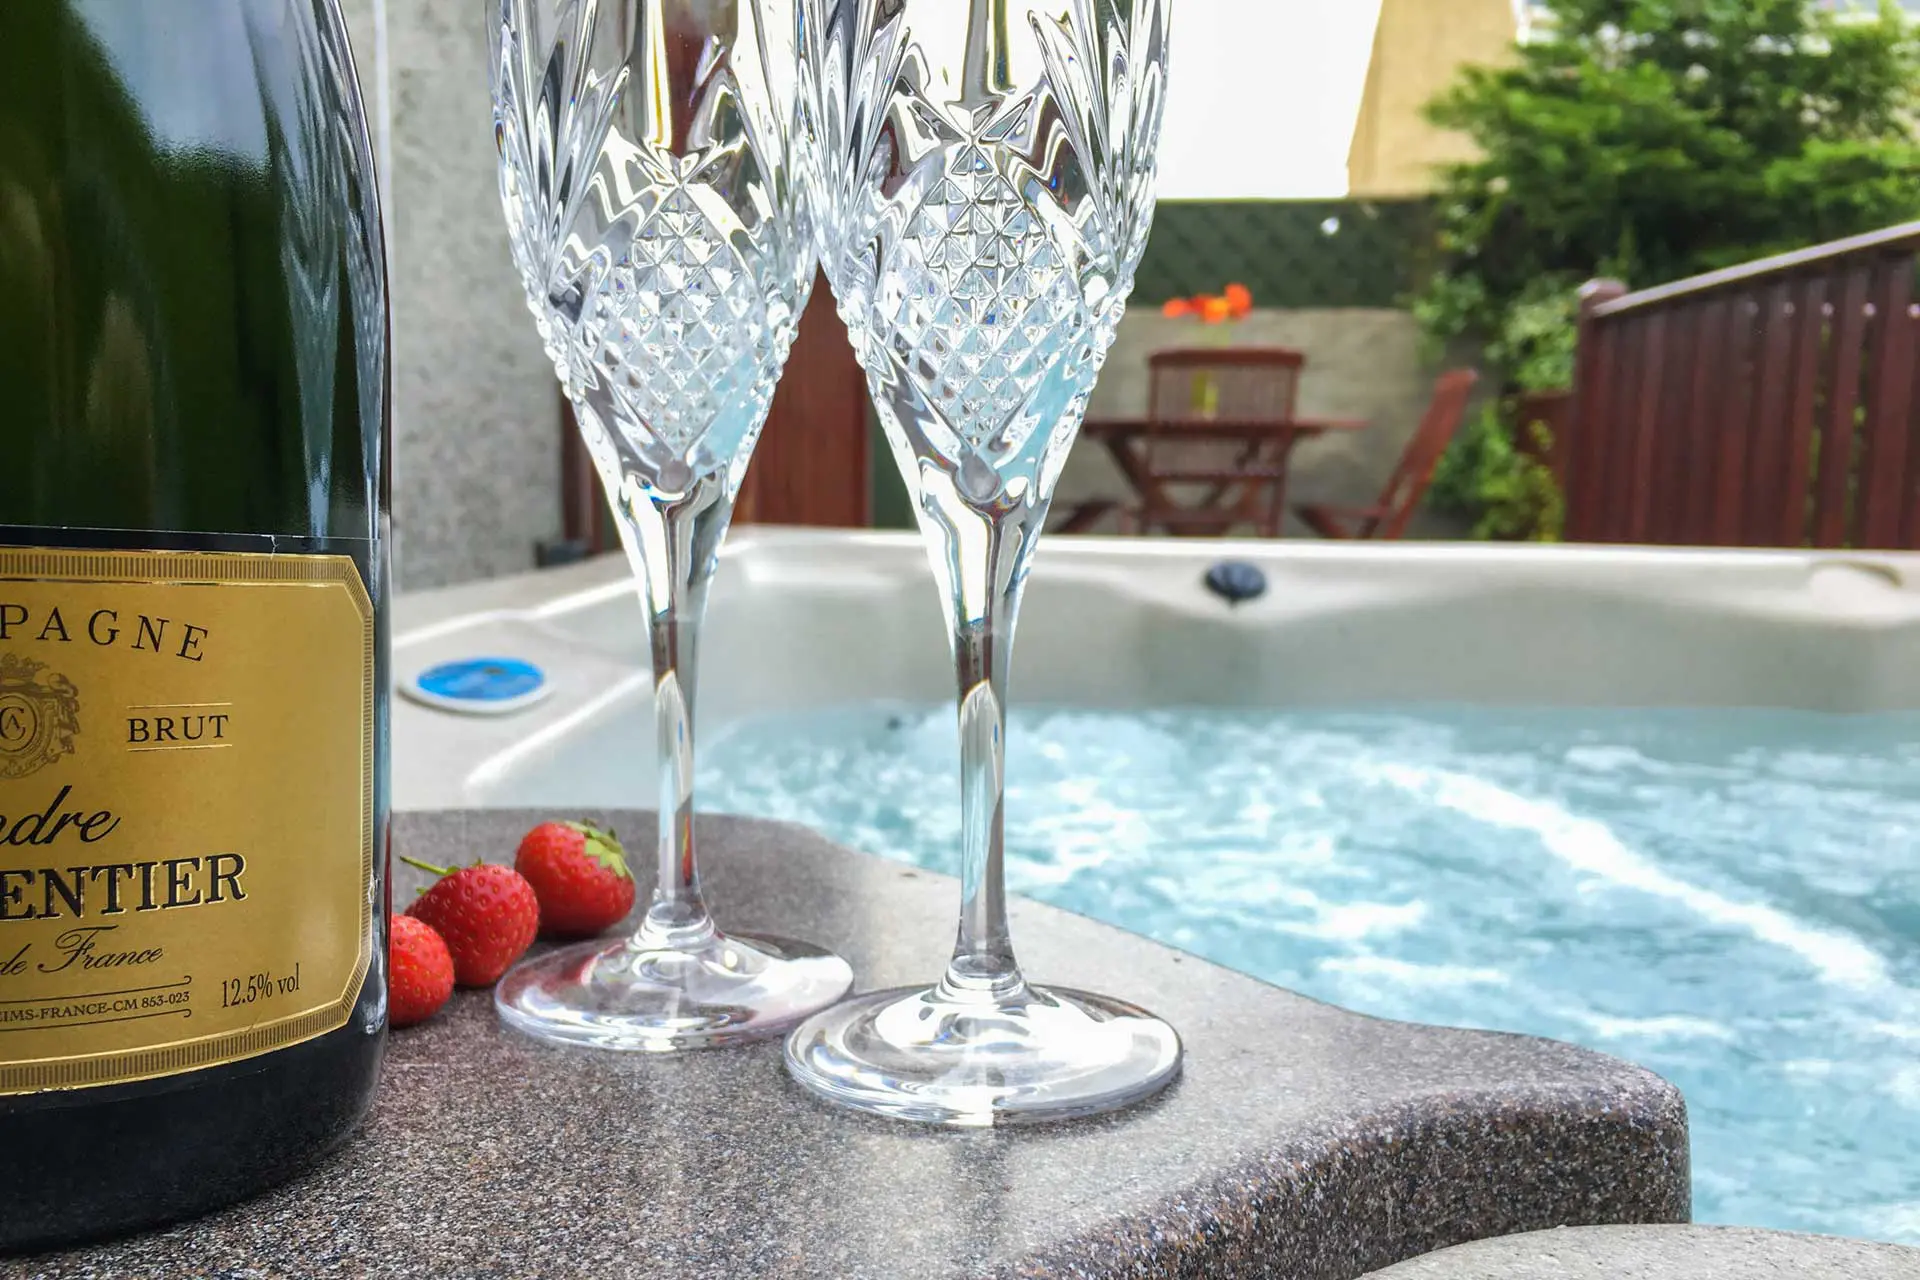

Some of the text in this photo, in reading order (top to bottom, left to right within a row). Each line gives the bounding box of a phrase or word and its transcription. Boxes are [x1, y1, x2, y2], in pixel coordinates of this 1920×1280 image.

[0, 604, 209, 662] PAGNE
[126, 715, 230, 743] BRUT
[0, 852, 249, 922] ENTIER
[37, 925, 164, 973] France
[141, 991, 191, 1009] 853-023
[221, 962, 300, 1009] 12.5% vol
